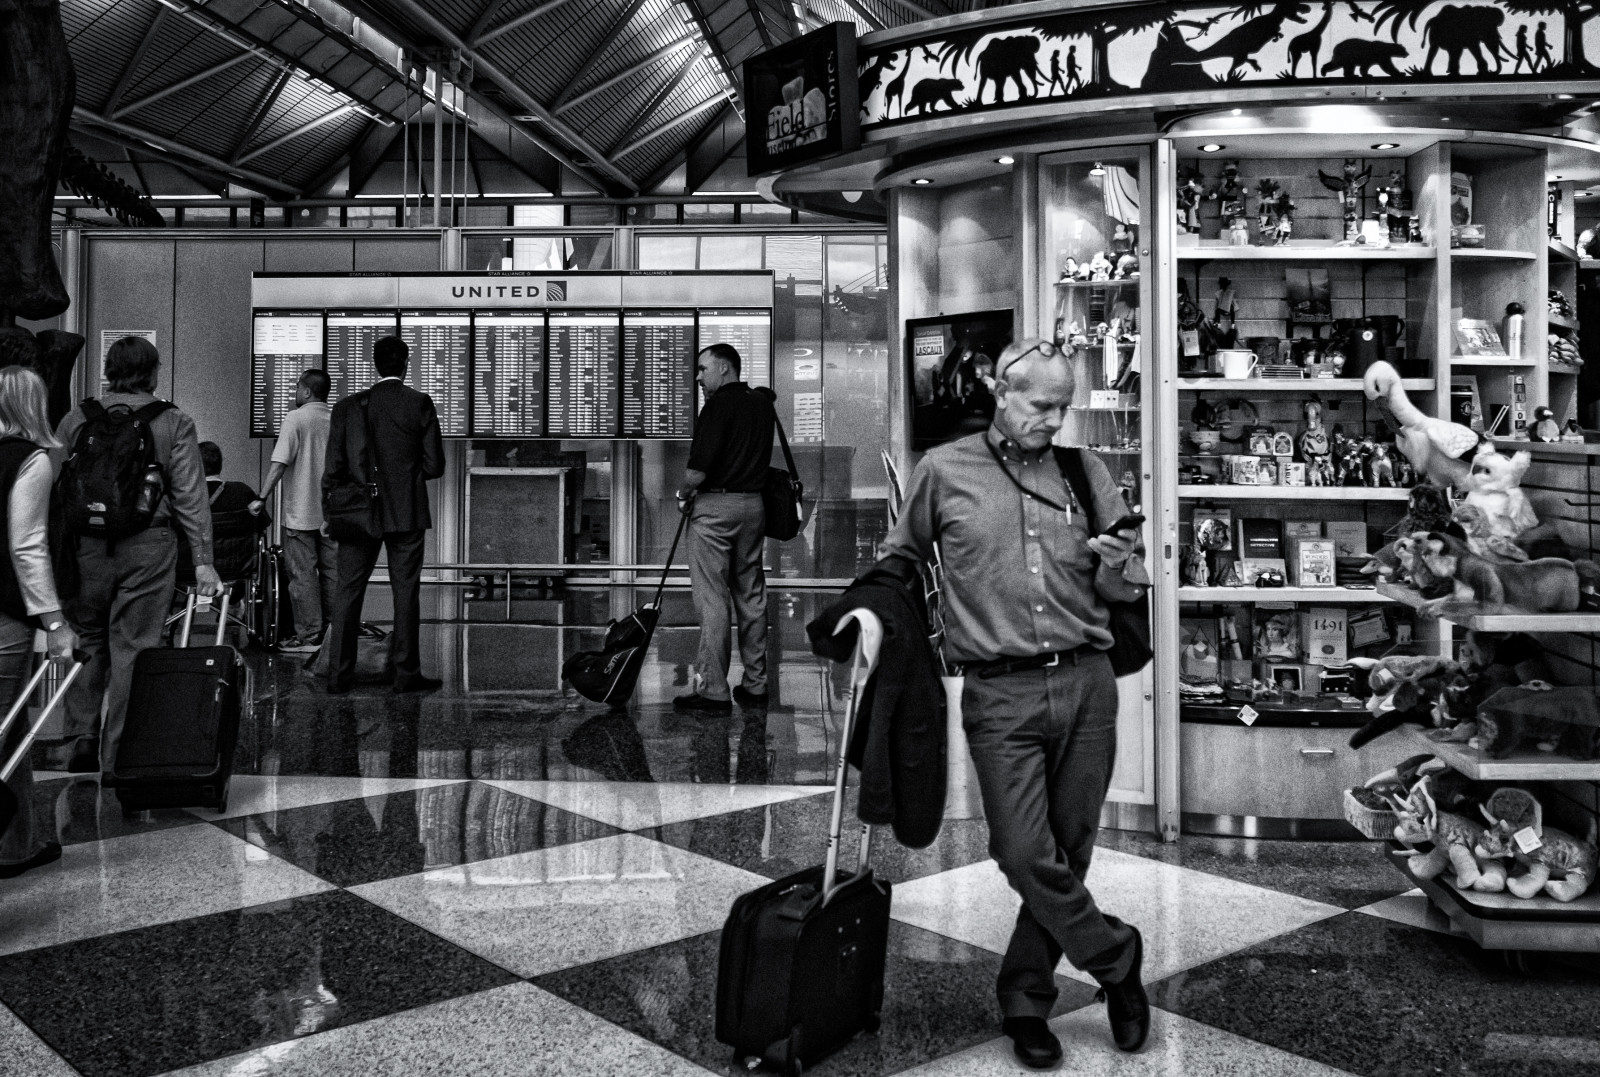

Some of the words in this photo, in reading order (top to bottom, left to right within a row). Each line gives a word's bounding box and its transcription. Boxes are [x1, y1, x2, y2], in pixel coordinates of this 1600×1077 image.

[451, 285, 540, 298] UNITED
[915, 345, 943, 356] LASCAUX
[1313, 617, 1344, 634] 1491
